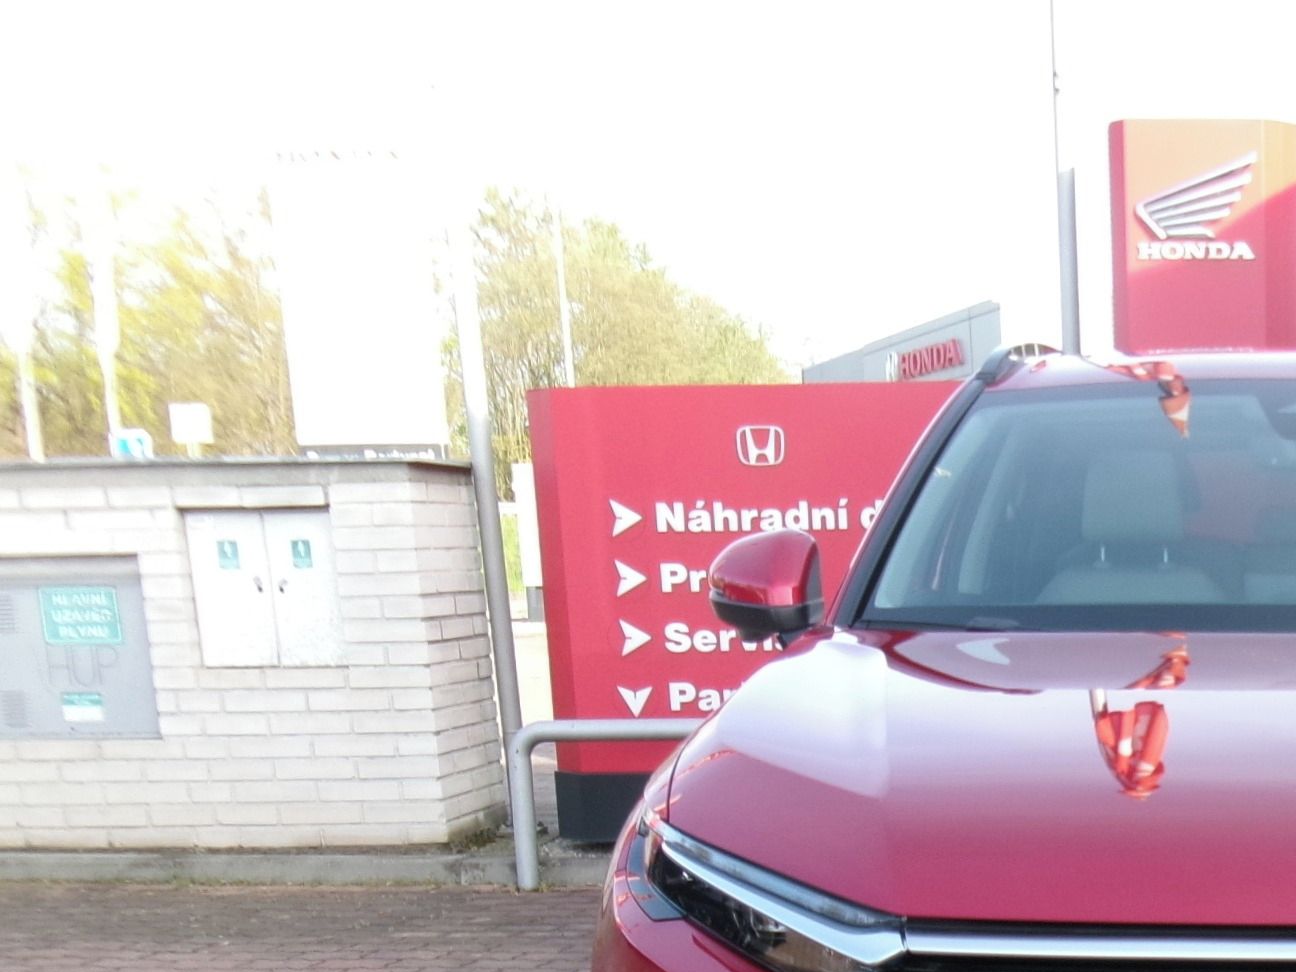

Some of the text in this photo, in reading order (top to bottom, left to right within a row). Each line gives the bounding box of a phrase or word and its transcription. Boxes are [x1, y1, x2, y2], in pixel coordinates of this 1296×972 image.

[1136, 240, 1256, 261] HONDA
[900, 336, 963, 380] HONDA
[655, 498, 849, 533] Náhradní
